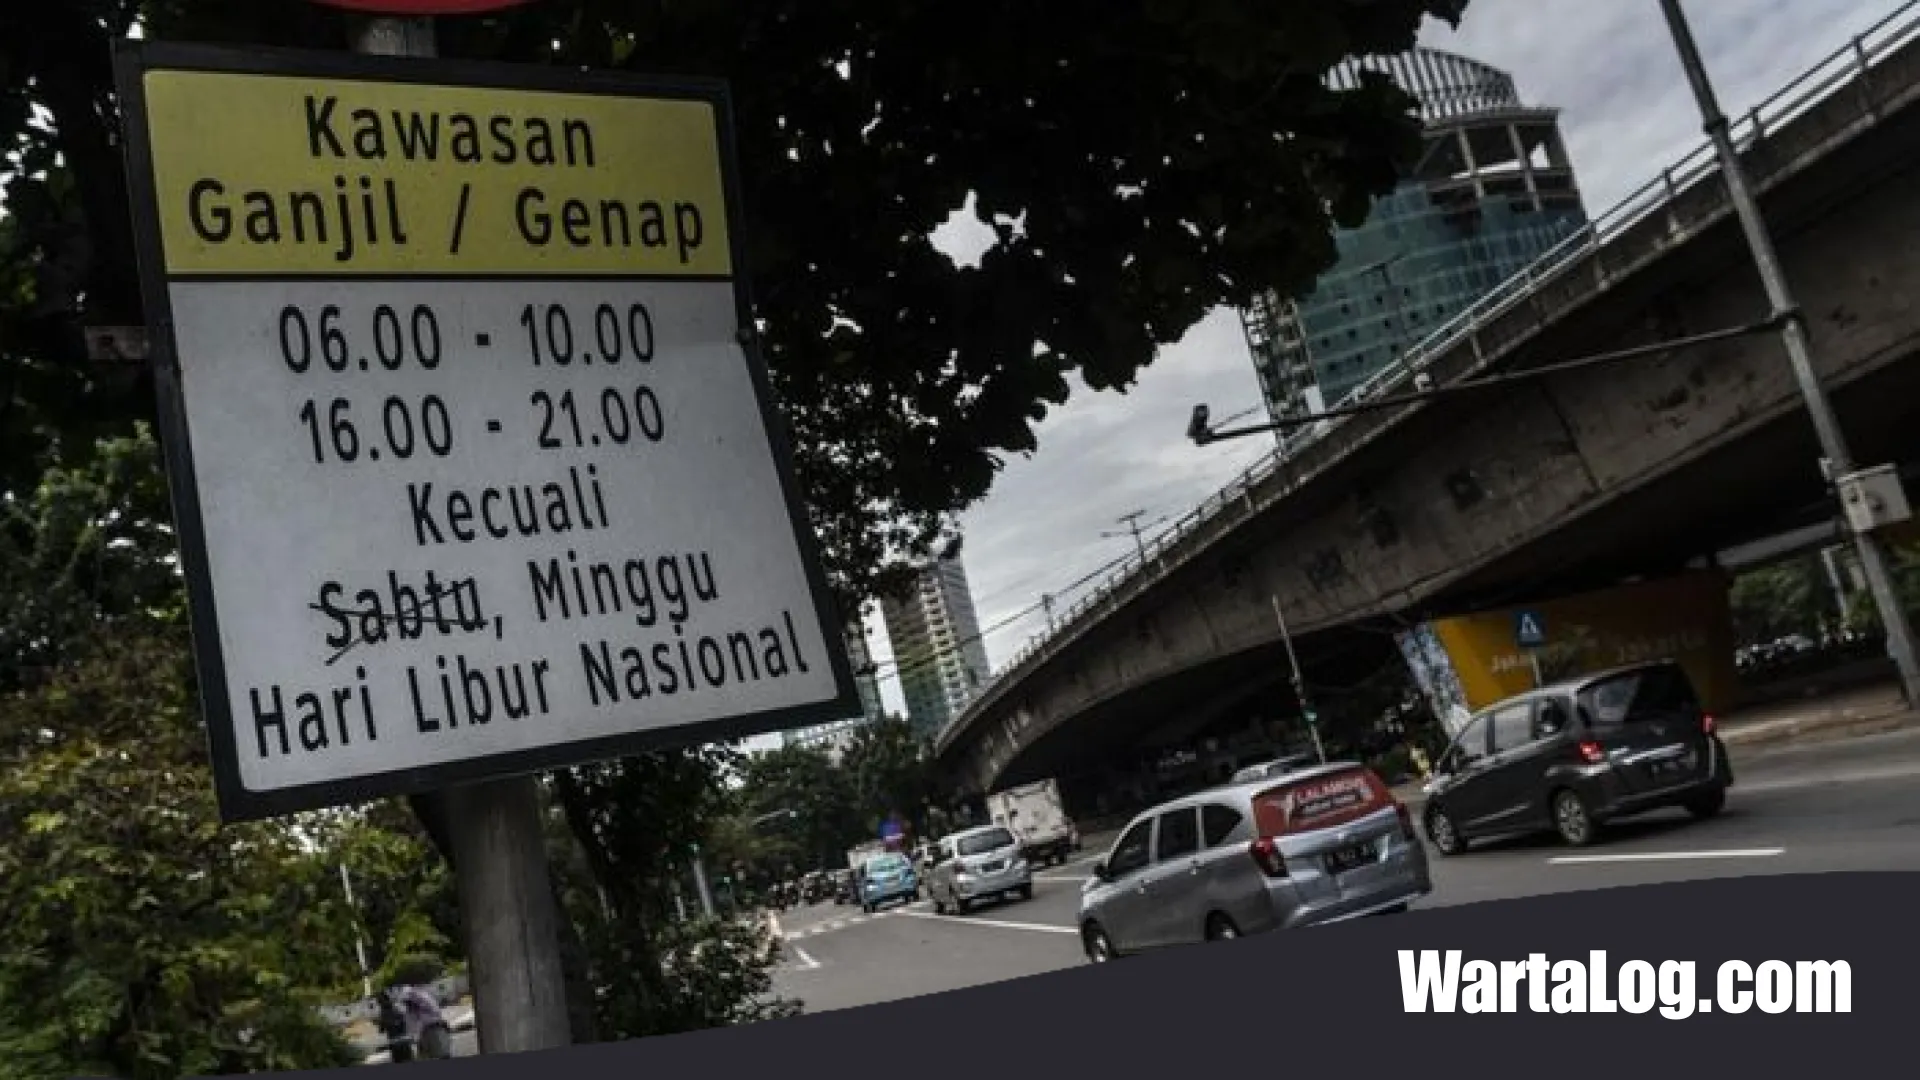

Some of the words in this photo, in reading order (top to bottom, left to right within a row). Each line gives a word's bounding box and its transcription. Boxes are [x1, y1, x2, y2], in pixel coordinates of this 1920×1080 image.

[303, 95, 597, 168] Kawasan
[187, 175, 407, 262] Ganjil
[449, 183, 471, 255] /
[515, 187, 703, 264] Genap
[278, 303, 442, 374] 06.00
[520, 302, 655, 366] 10.00
[298, 394, 453, 464] 16.00
[530, 384, 665, 450] 21.00
[407, 463, 610, 546] Kecuali
[317, 569, 503, 649] Sabtu,
[527, 551, 719, 627] Minggu
[249, 665, 378, 757] Hari
[406, 654, 551, 734] Libur
[578, 609, 809, 706] Nasional
